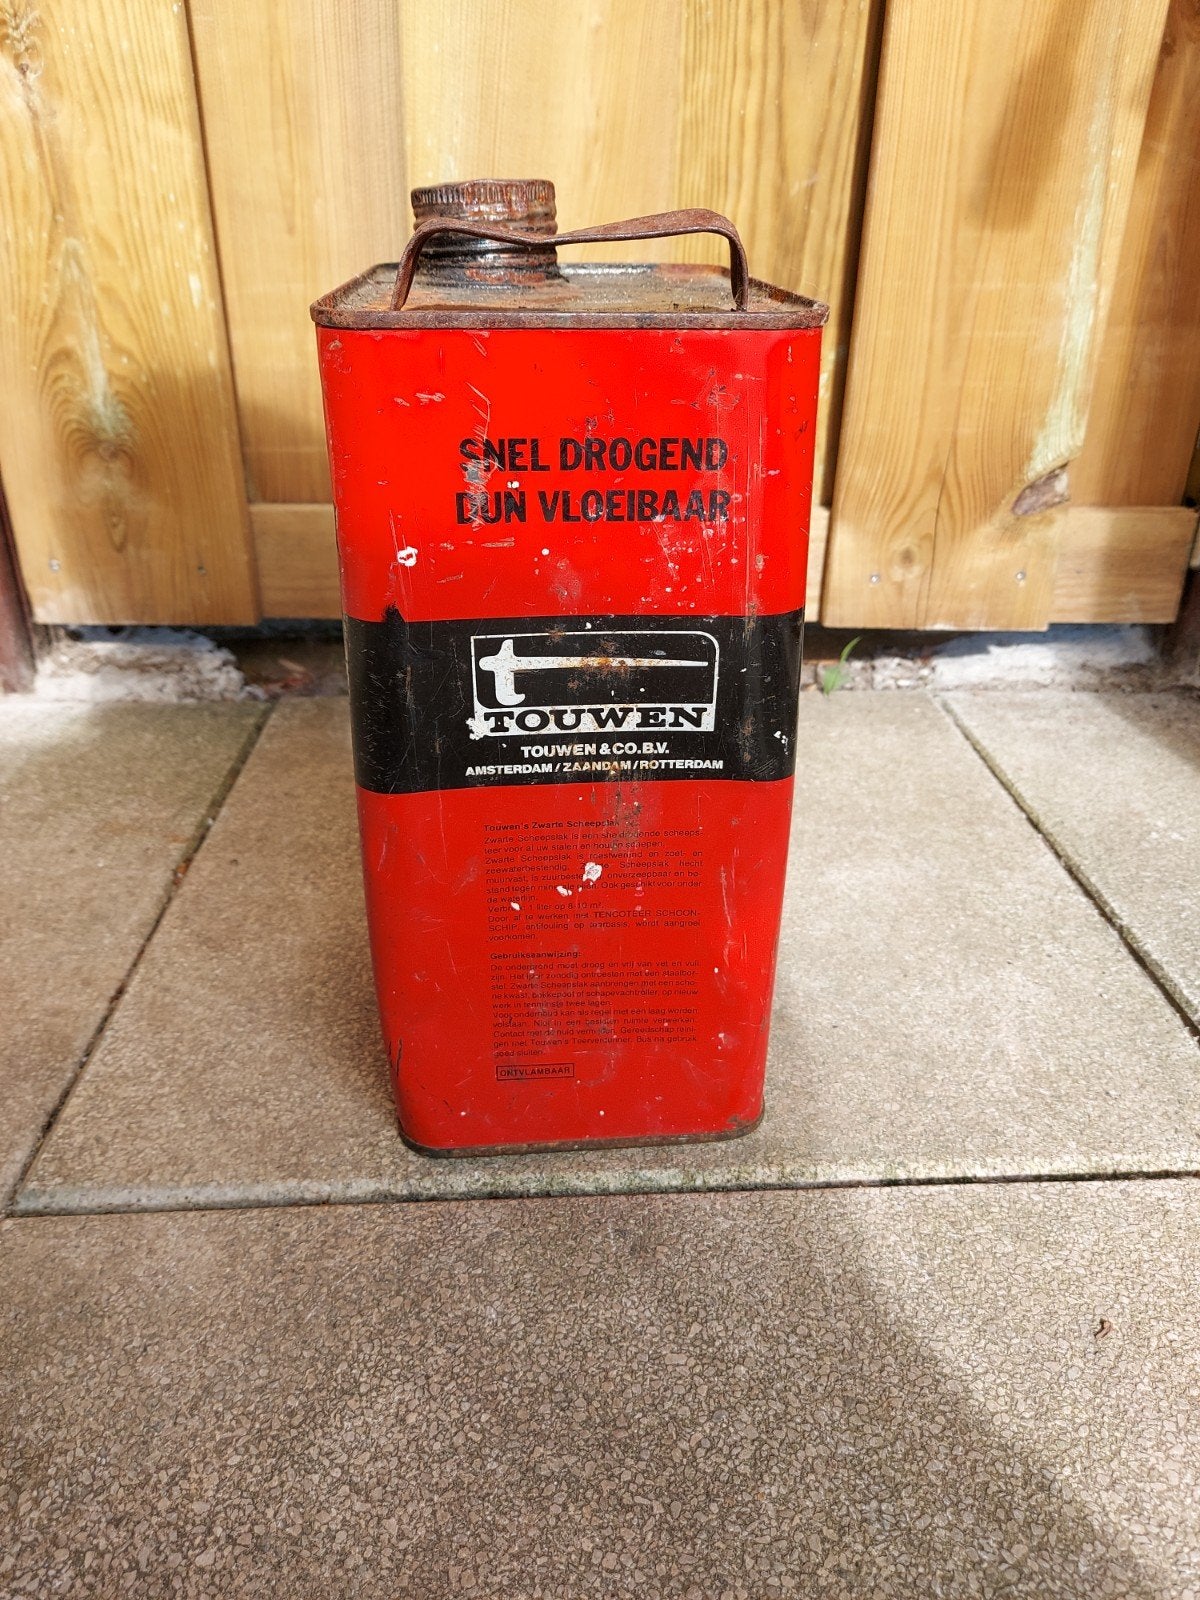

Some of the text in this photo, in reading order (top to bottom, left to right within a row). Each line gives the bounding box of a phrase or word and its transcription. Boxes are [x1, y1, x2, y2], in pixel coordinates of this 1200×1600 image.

[459, 438, 728, 472] SNEL DROGEND
[455, 489, 729, 525] DUN VLOEIBAAR
[484, 706, 708, 733] TOUWEN
[521, 744, 596, 758] TOUWEN
[465, 763, 552, 776] AMSTERDAM
[562, 761, 632, 772] ZAANDAM
[640, 760, 724, 771] ROTTERDAM
[532, 821, 563, 829] Zwarte
[499, 1066, 571, 1077] ONTVLAMBAAR
